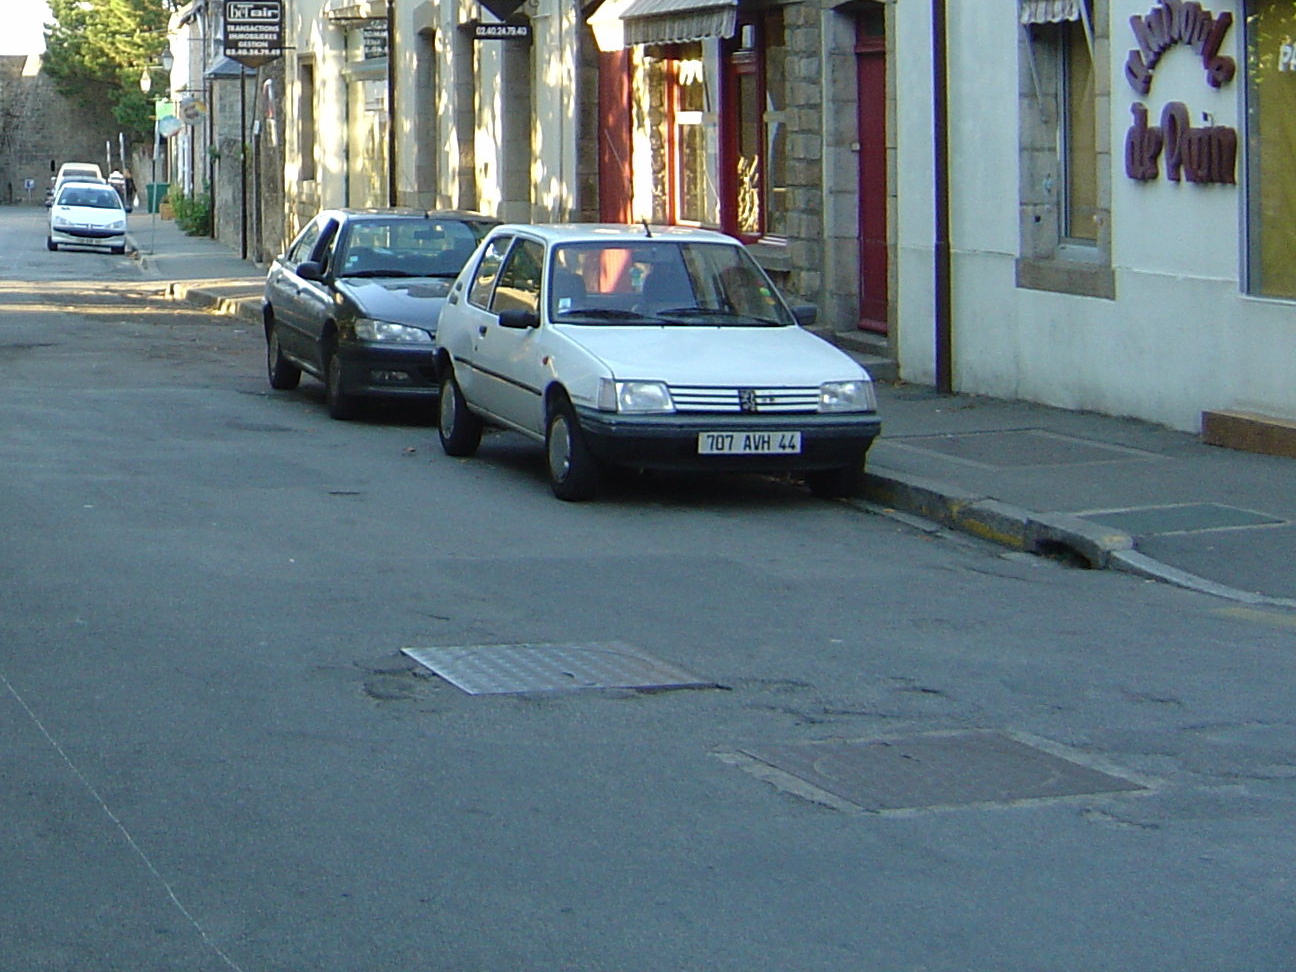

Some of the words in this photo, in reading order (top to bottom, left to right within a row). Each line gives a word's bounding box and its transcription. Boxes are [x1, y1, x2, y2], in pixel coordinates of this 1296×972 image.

[226, 24, 280, 32] TRANSACTIONS
[228, 32, 278, 40] IMMOBILIERES
[706, 434, 734, 451] 707
[743, 434, 771, 451] AVH
[778, 434, 797, 450] 44
